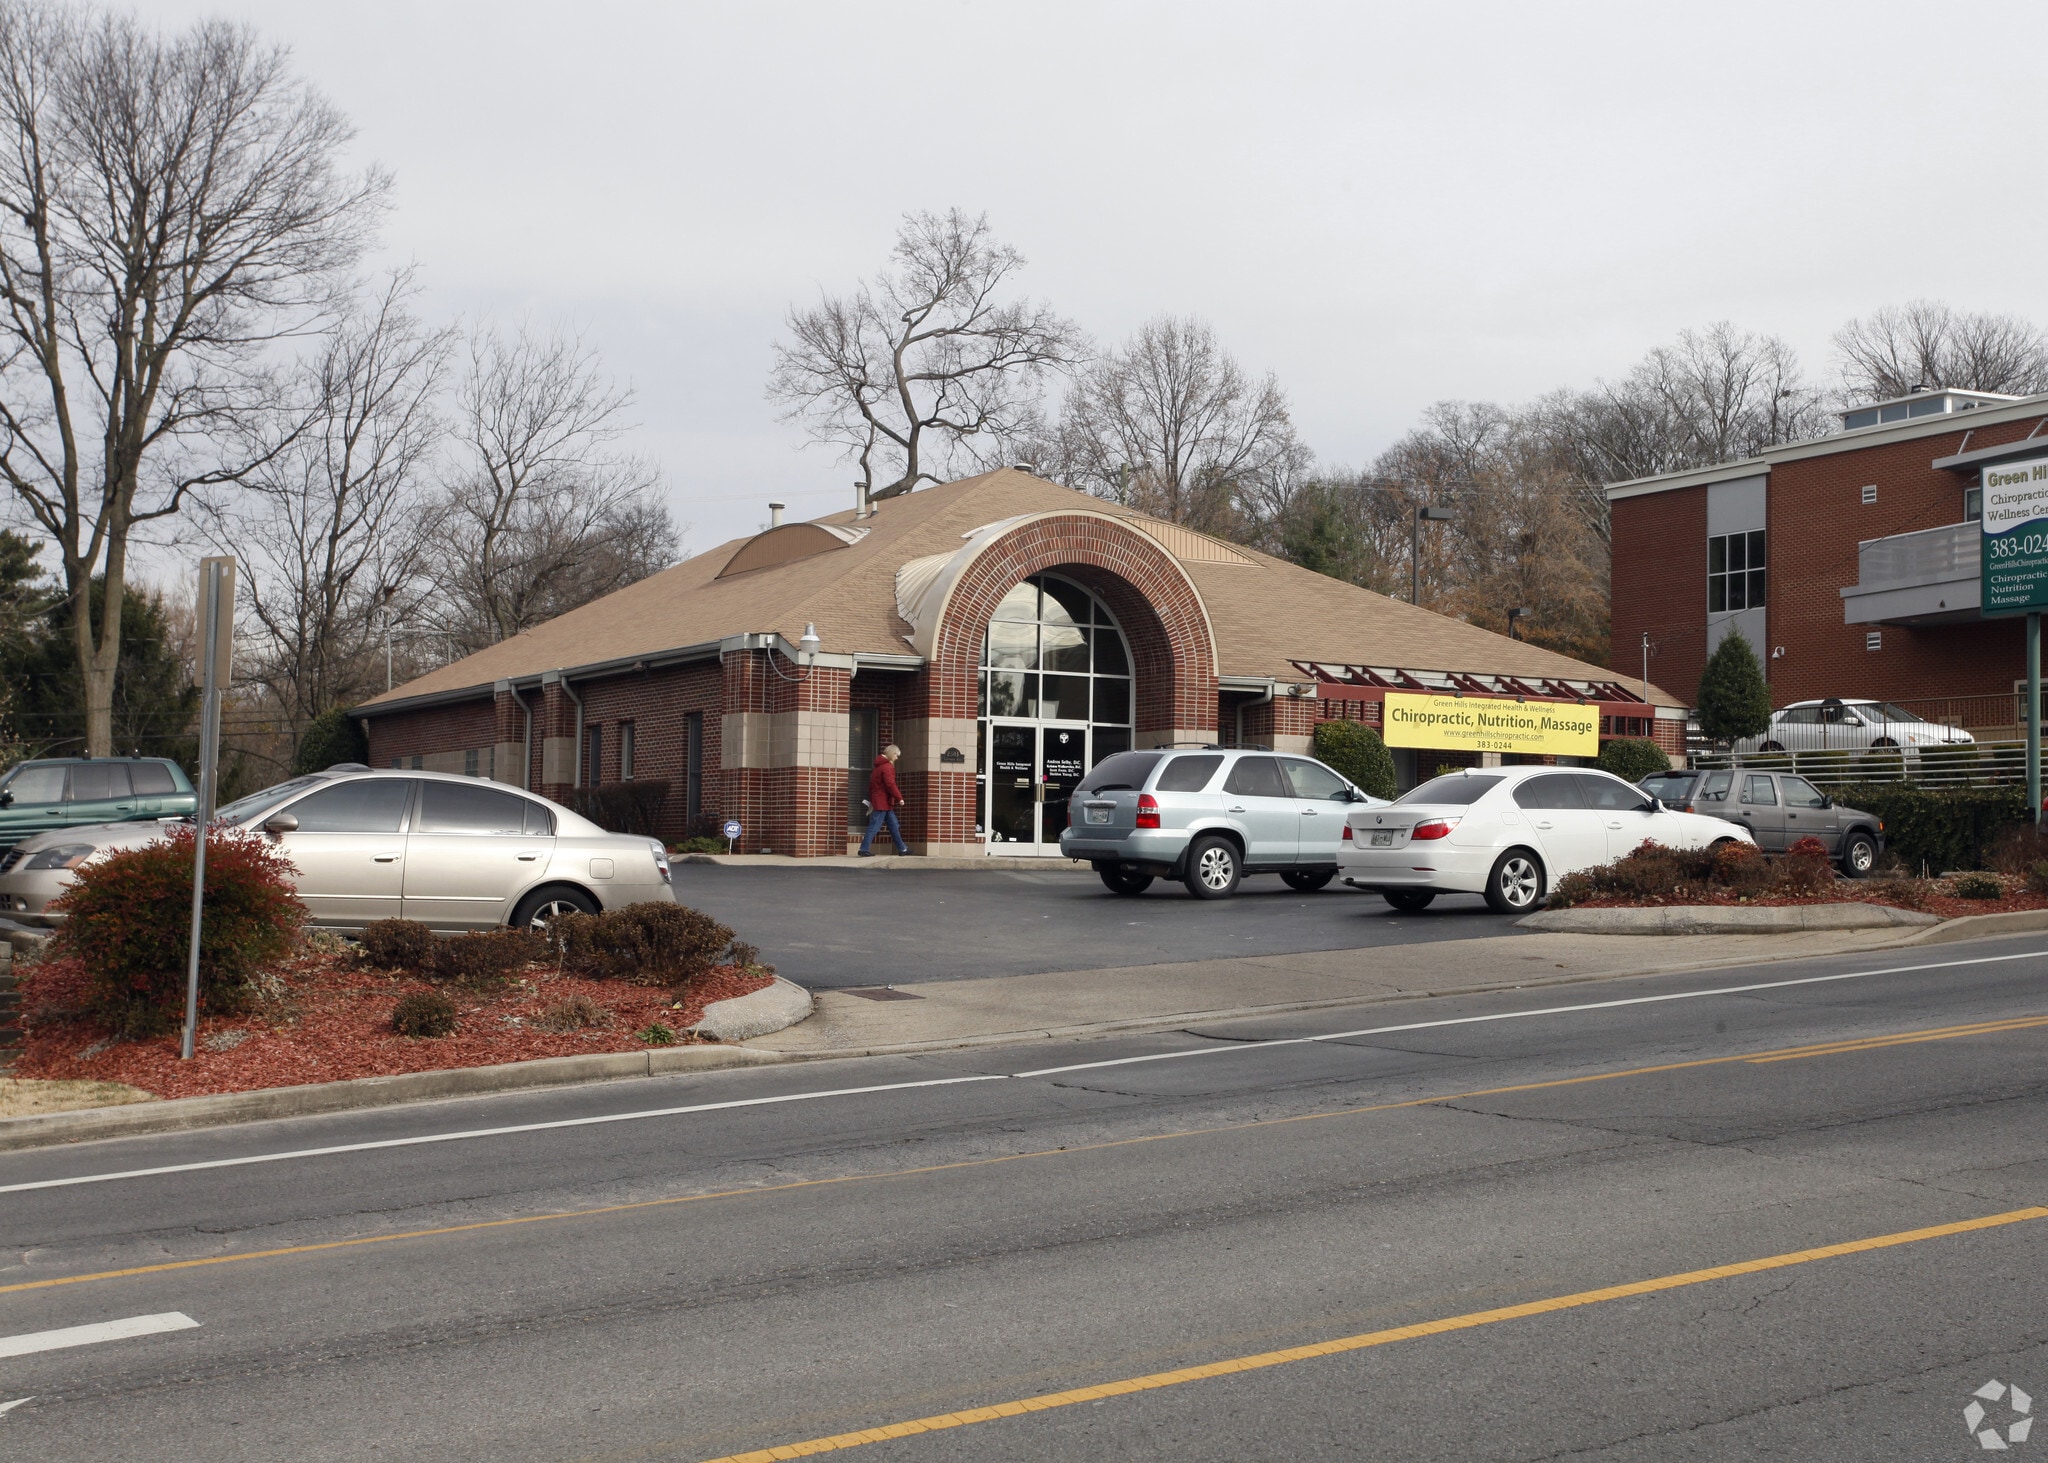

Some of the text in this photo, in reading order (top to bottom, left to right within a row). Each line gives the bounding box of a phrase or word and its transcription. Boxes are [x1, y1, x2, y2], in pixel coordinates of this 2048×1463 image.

[1987, 471, 2029, 487] Green
[1987, 508, 2030, 521] Wellness
[1990, 570, 2048, 583] Chiropractic
[1991, 583, 2034, 594] Nutrition
[1991, 594, 2031, 605] Massage
[1433, 699, 1556, 713] Green Hills Integrated Health & Wellness
[1392, 708, 1593, 735] Chiropractic, Nutrition, Massage
[1444, 729, 1544, 740] www.greenhillschiropractic.com
[1476, 740, 1512, 749] 383-0244
